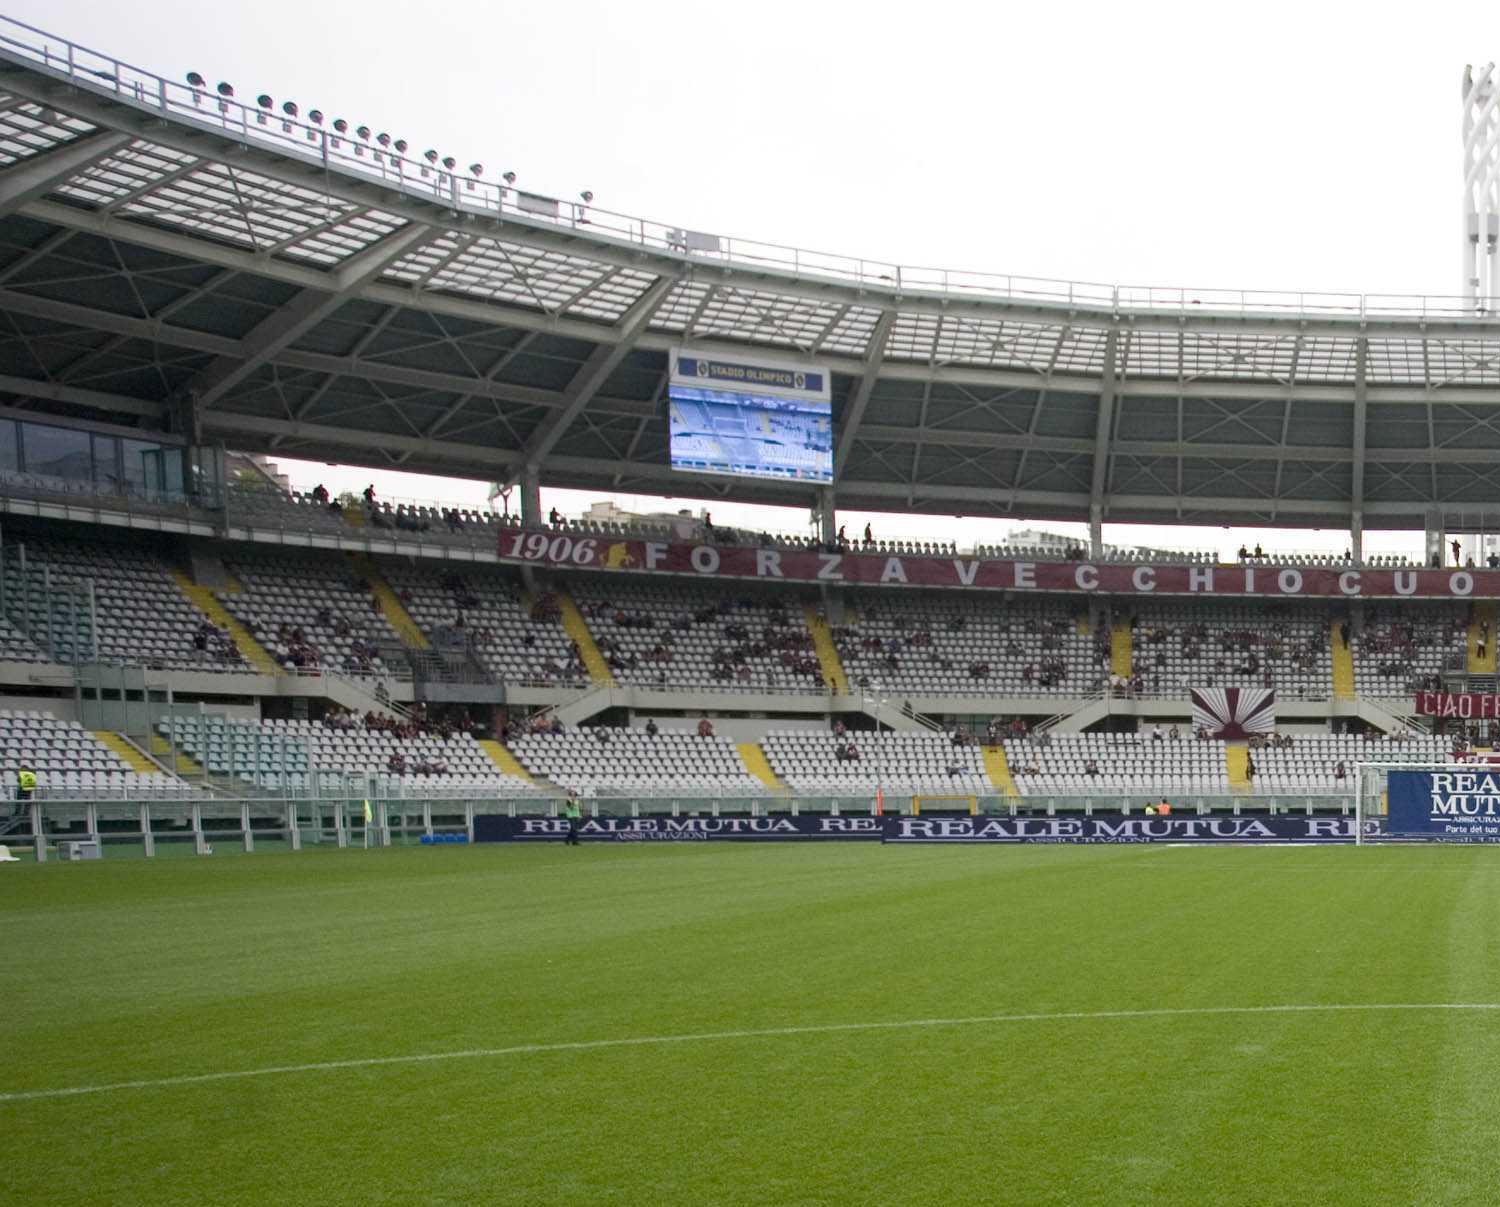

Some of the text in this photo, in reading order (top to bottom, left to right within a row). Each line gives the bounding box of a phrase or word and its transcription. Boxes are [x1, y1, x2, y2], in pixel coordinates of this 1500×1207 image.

[710, 366, 792, 385] STADIO OLIMPICO
[505, 532, 597, 564] 1906
[644, 542, 907, 583] FORZA
[953, 560, 1303, 594] VECCHIO
[1424, 693, 1472, 719] CIAO
[522, 818, 884, 833] REALE MUTUA RE
[899, 820, 1393, 838] REALE MUTUA RE
[1445, 825, 1468, 834] Parte
[1470, 825, 1483, 834] del
[1485, 825, 1498, 834] tuo
